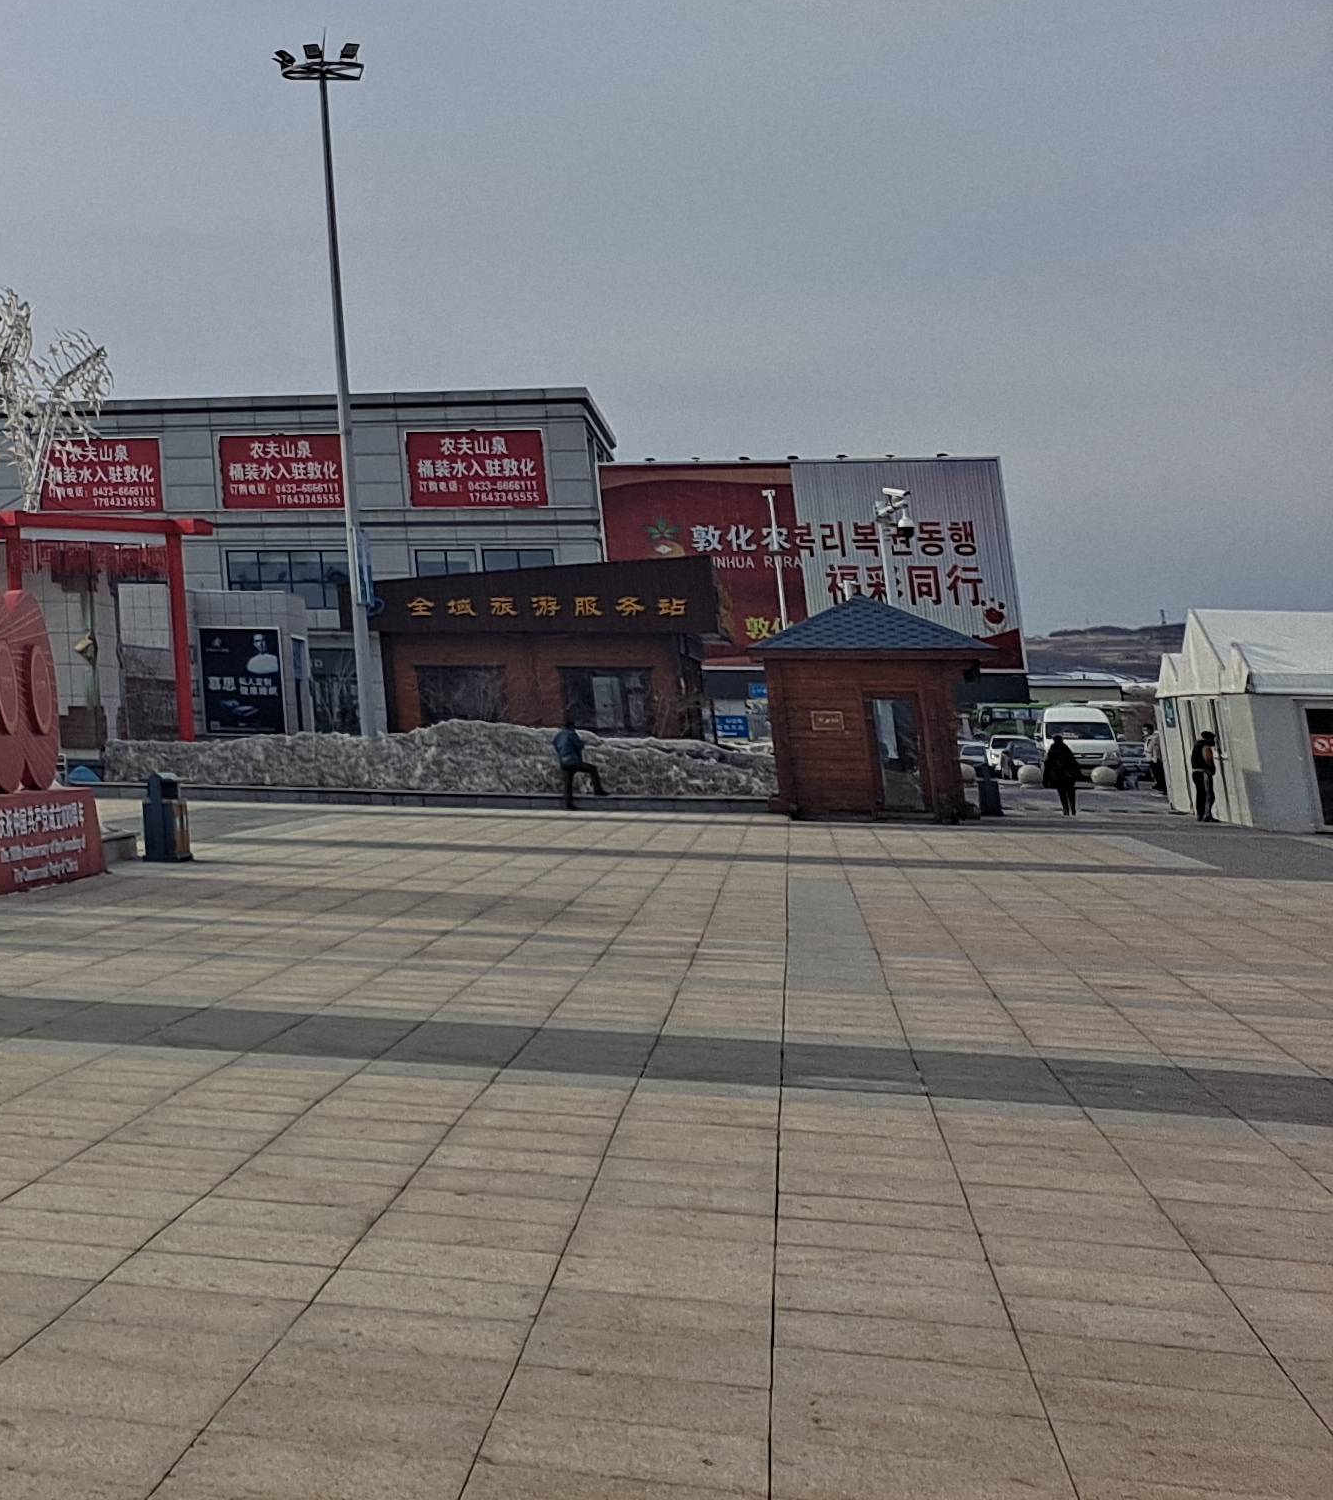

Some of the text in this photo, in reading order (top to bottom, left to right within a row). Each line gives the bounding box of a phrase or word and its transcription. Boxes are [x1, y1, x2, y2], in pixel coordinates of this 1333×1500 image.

[69, 444, 128, 462] 农夫山泉
[250, 441, 312, 458] 农夫山泉
[440, 436, 508, 455] 农夫山泉
[229, 461, 338, 480] 桶装水入驻敦化
[418, 458, 537, 478] 桶装水入驻敦化
[407, 597, 687, 616] 全域旅游服务站
